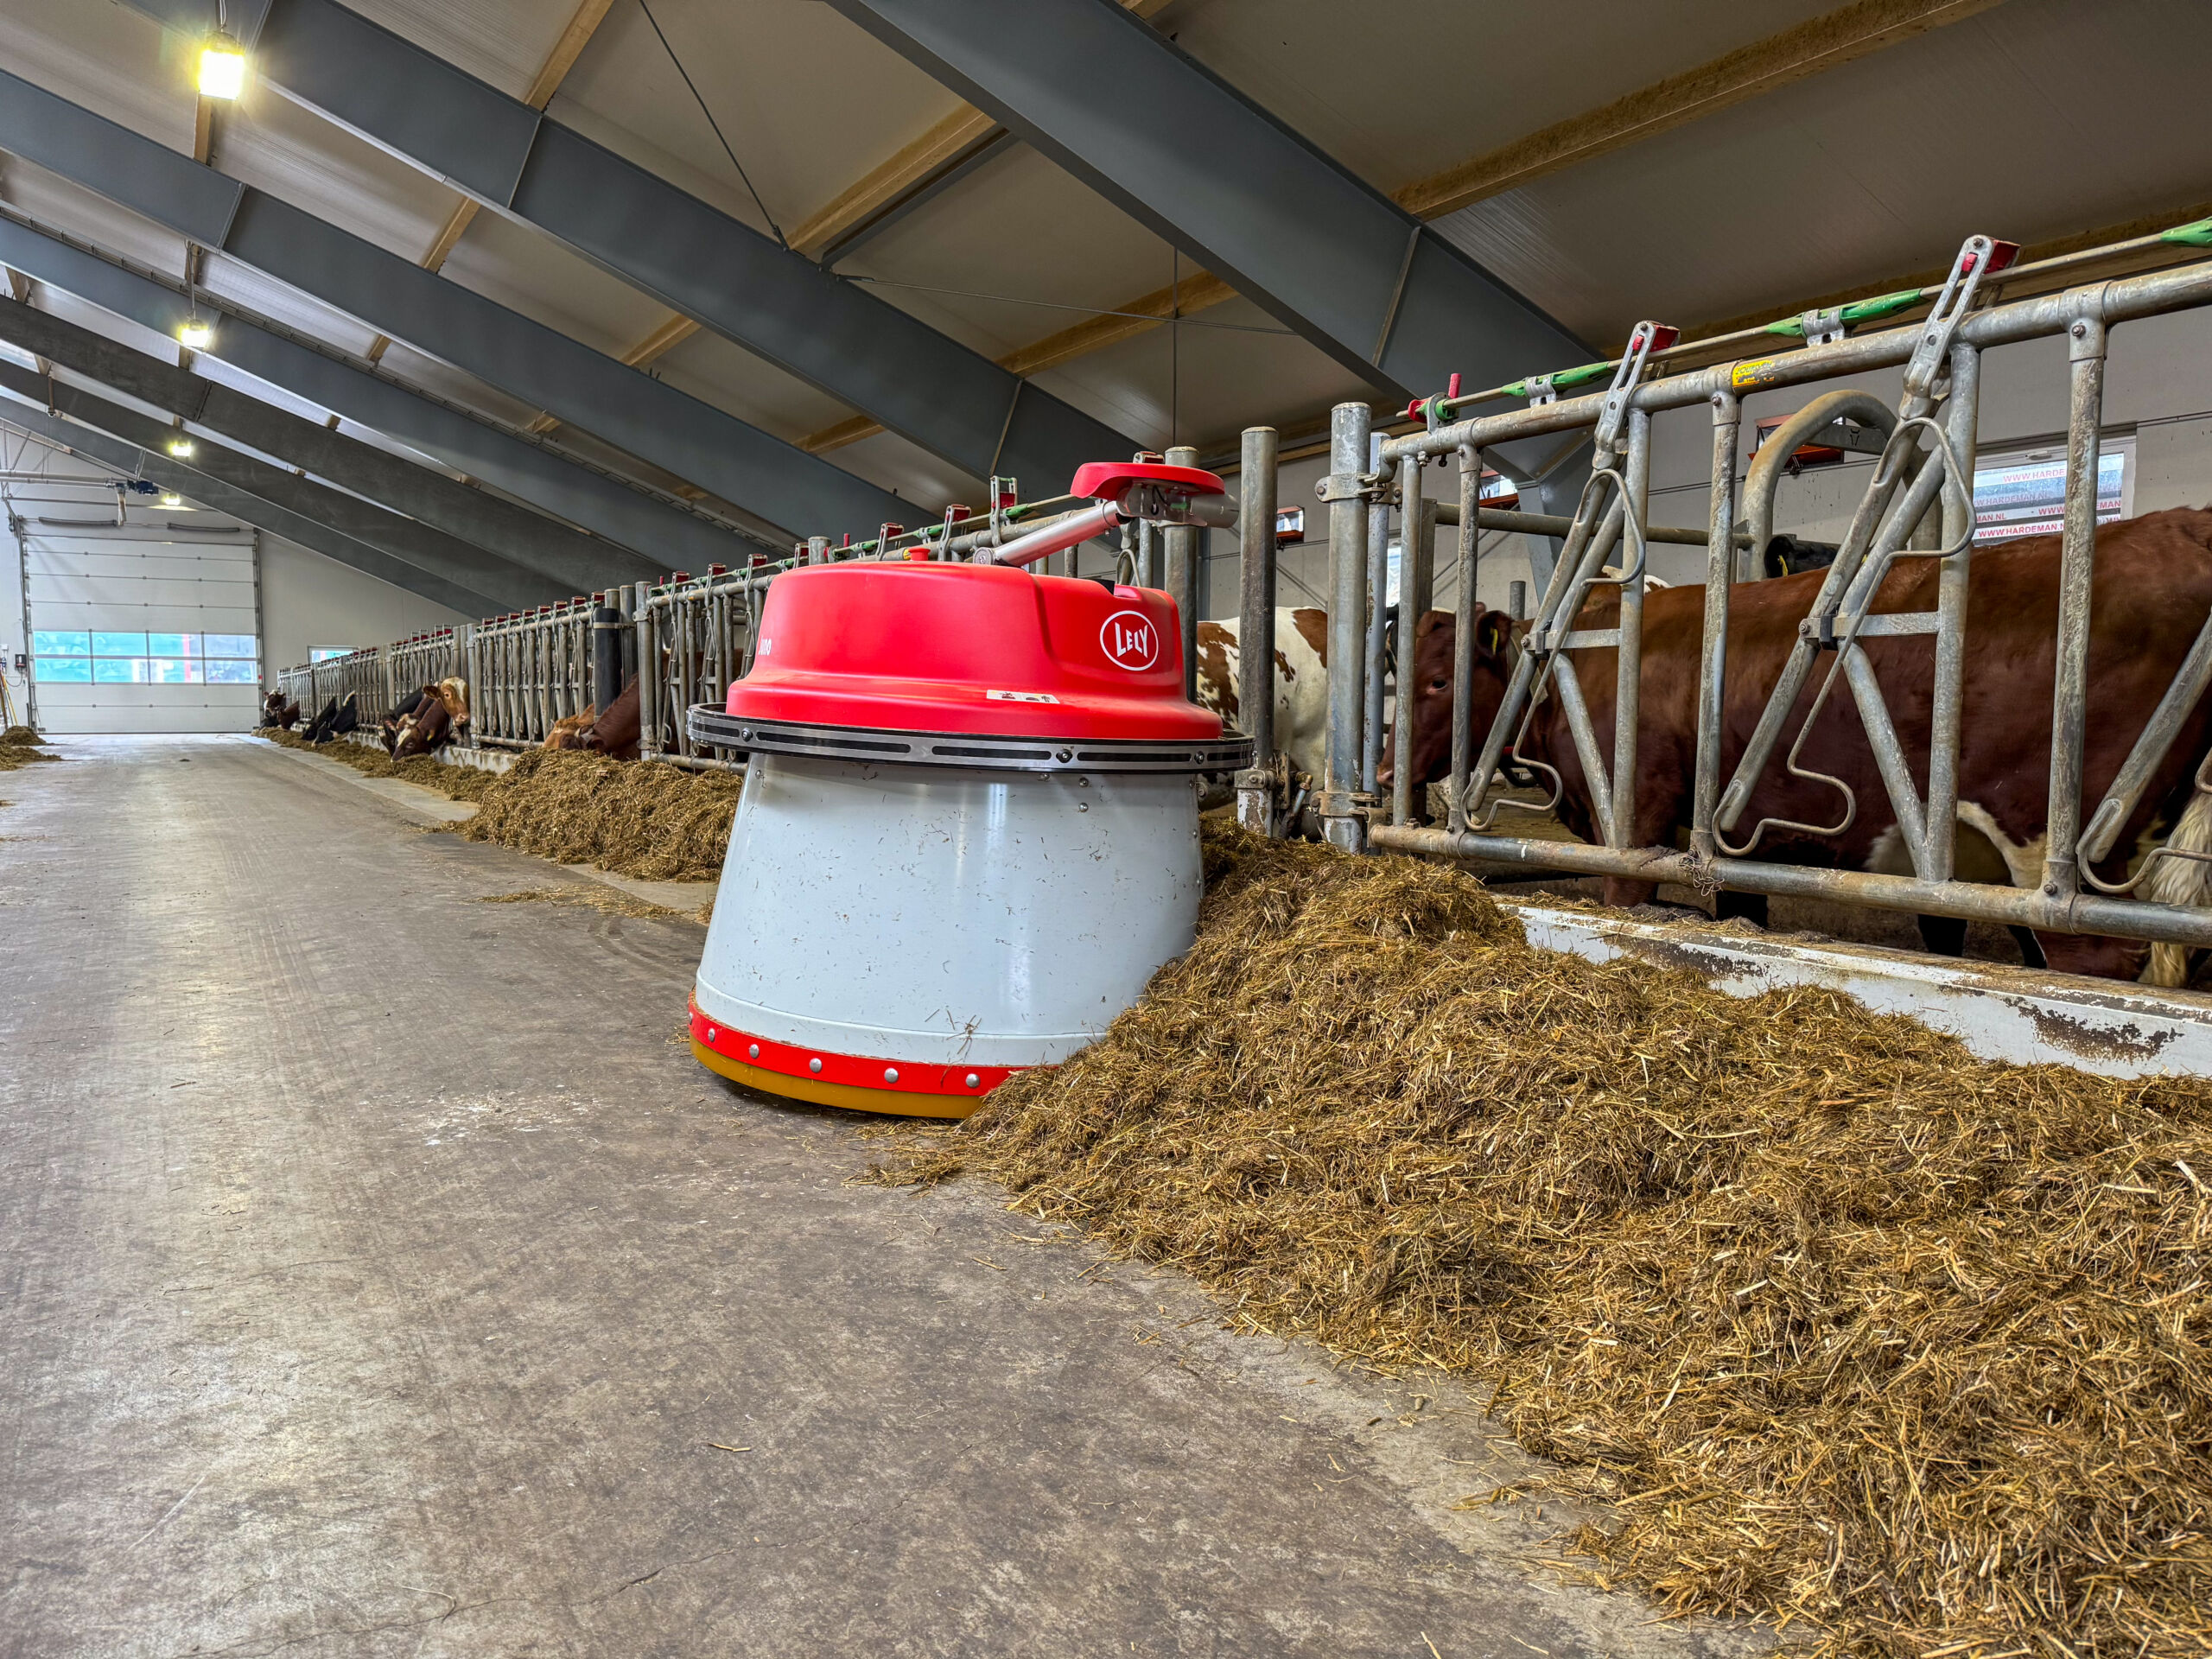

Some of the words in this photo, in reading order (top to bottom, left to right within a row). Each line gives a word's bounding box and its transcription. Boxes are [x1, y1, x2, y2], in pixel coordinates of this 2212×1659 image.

[2003, 468, 2065, 483] WWW.HARDE
[1974, 492, 2050, 506] W.HARDEMAN.NL
[1978, 523, 2064, 537] WWW.HARDEMAN.N
[1115, 621, 1148, 658] LELY
